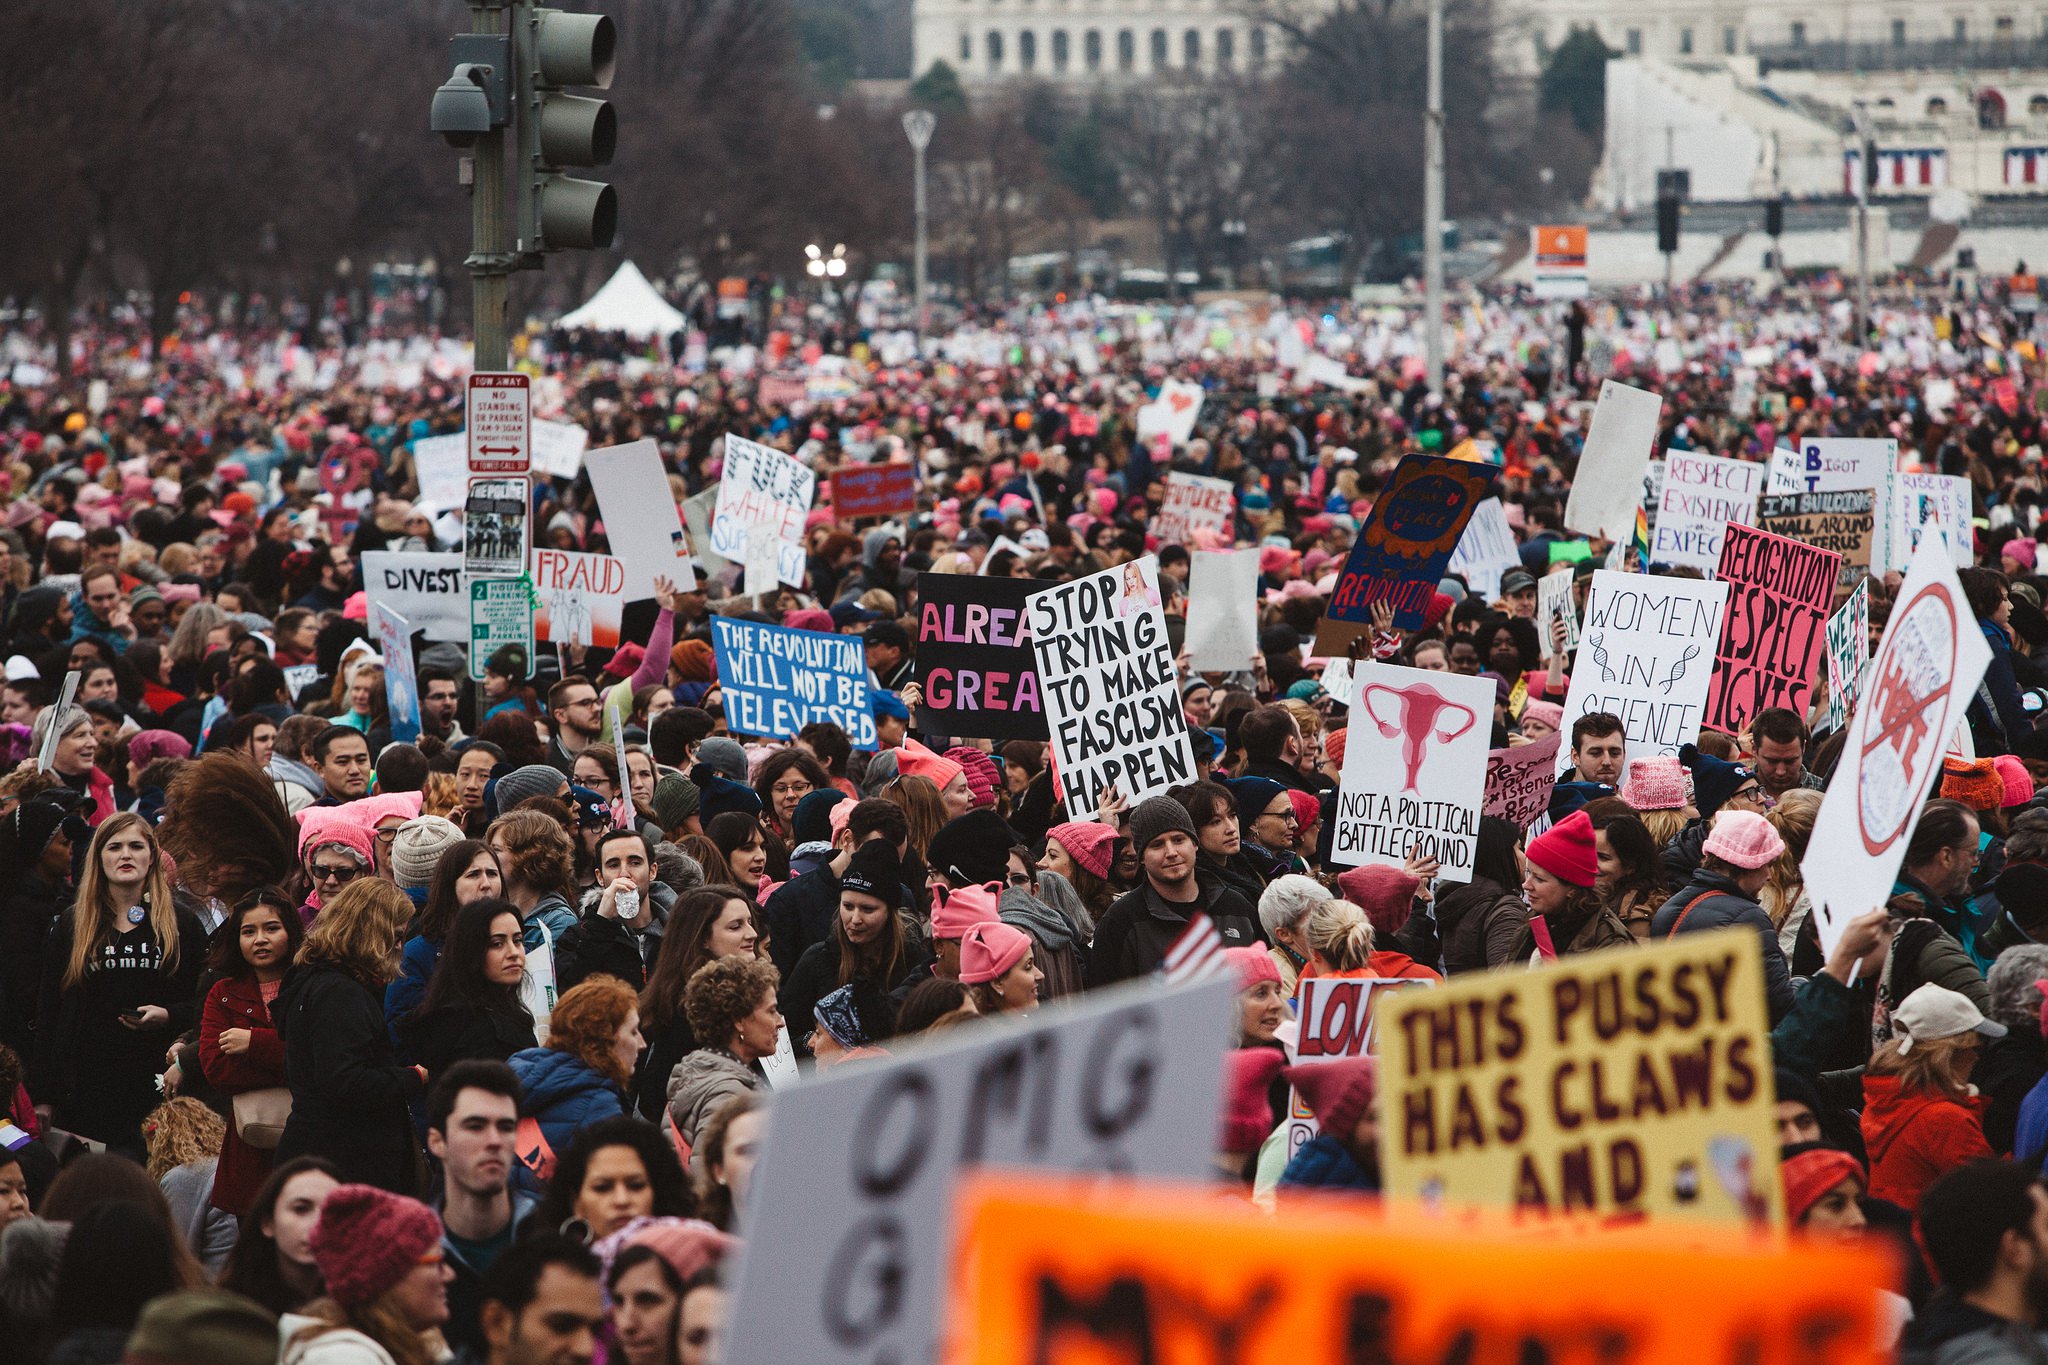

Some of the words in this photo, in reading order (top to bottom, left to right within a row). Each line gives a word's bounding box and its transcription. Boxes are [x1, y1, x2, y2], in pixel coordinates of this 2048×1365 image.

[476, 377, 493, 386] TOW
[496, 378, 522, 386] AWAY
[492, 391, 506, 399] NO
[475, 414, 487, 422] OR
[489, 414, 523, 422] PARKING
[478, 403, 521, 411] STANDING
[470, 484, 488, 500] THE
[726, 437, 811, 511] FUCK
[1670, 457, 1758, 494] RESPECT
[721, 478, 804, 541] WHITE
[1164, 483, 1228, 514] FUTURE
[1657, 527, 1720, 556] EXPEC
[1770, 518, 1815, 535] WALL
[1816, 515, 1875, 534] AROUND
[384, 568, 461, 594] DIVEST
[537, 551, 625, 595] FRAUD
[1718, 525, 1840, 610] RECOGNITION
[476, 585, 484, 598] 2
[1035, 575, 1117, 637] STOP
[1335, 572, 1437, 615] REVOLUTION
[1590, 587, 1719, 639] WOMEN
[716, 620, 754, 652] THE
[758, 628, 863, 675] REVOLUTION
[919, 602, 1032, 648] ALREA
[1034, 612, 1156, 677] TRYING
[1828, 605, 1848, 657] WE
[727, 649, 788, 691] WILL
[791, 665, 831, 704] NOT
[836, 675, 866, 708] BE
[926, 667, 1040, 713] GREA
[1046, 674, 1090, 718] TO
[1100, 643, 1174, 703] MAKE
[1620, 654, 1657, 688] IN
[1058, 688, 1187, 765] FASCISM
[1062, 739, 1189, 816] HAPPEN
[1487, 773, 1556, 805] xistence
[1340, 791, 1377, 820] NOT
[1378, 795, 1393, 824] A
[1398, 797, 1478, 838] POLITICAL
[1338, 820, 1473, 869] BATTLEGROUND.
[105, 942, 162, 958] asty
[1398, 992, 1527, 1077] THIS
[1552, 951, 1736, 1044] PUSSY
[849, 1005, 1162, 1200] OMG
[1402, 1076, 1527, 1156] HAS
[1552, 1035, 1758, 1131] CLAWS
[1513, 1138, 1647, 1222] AND
